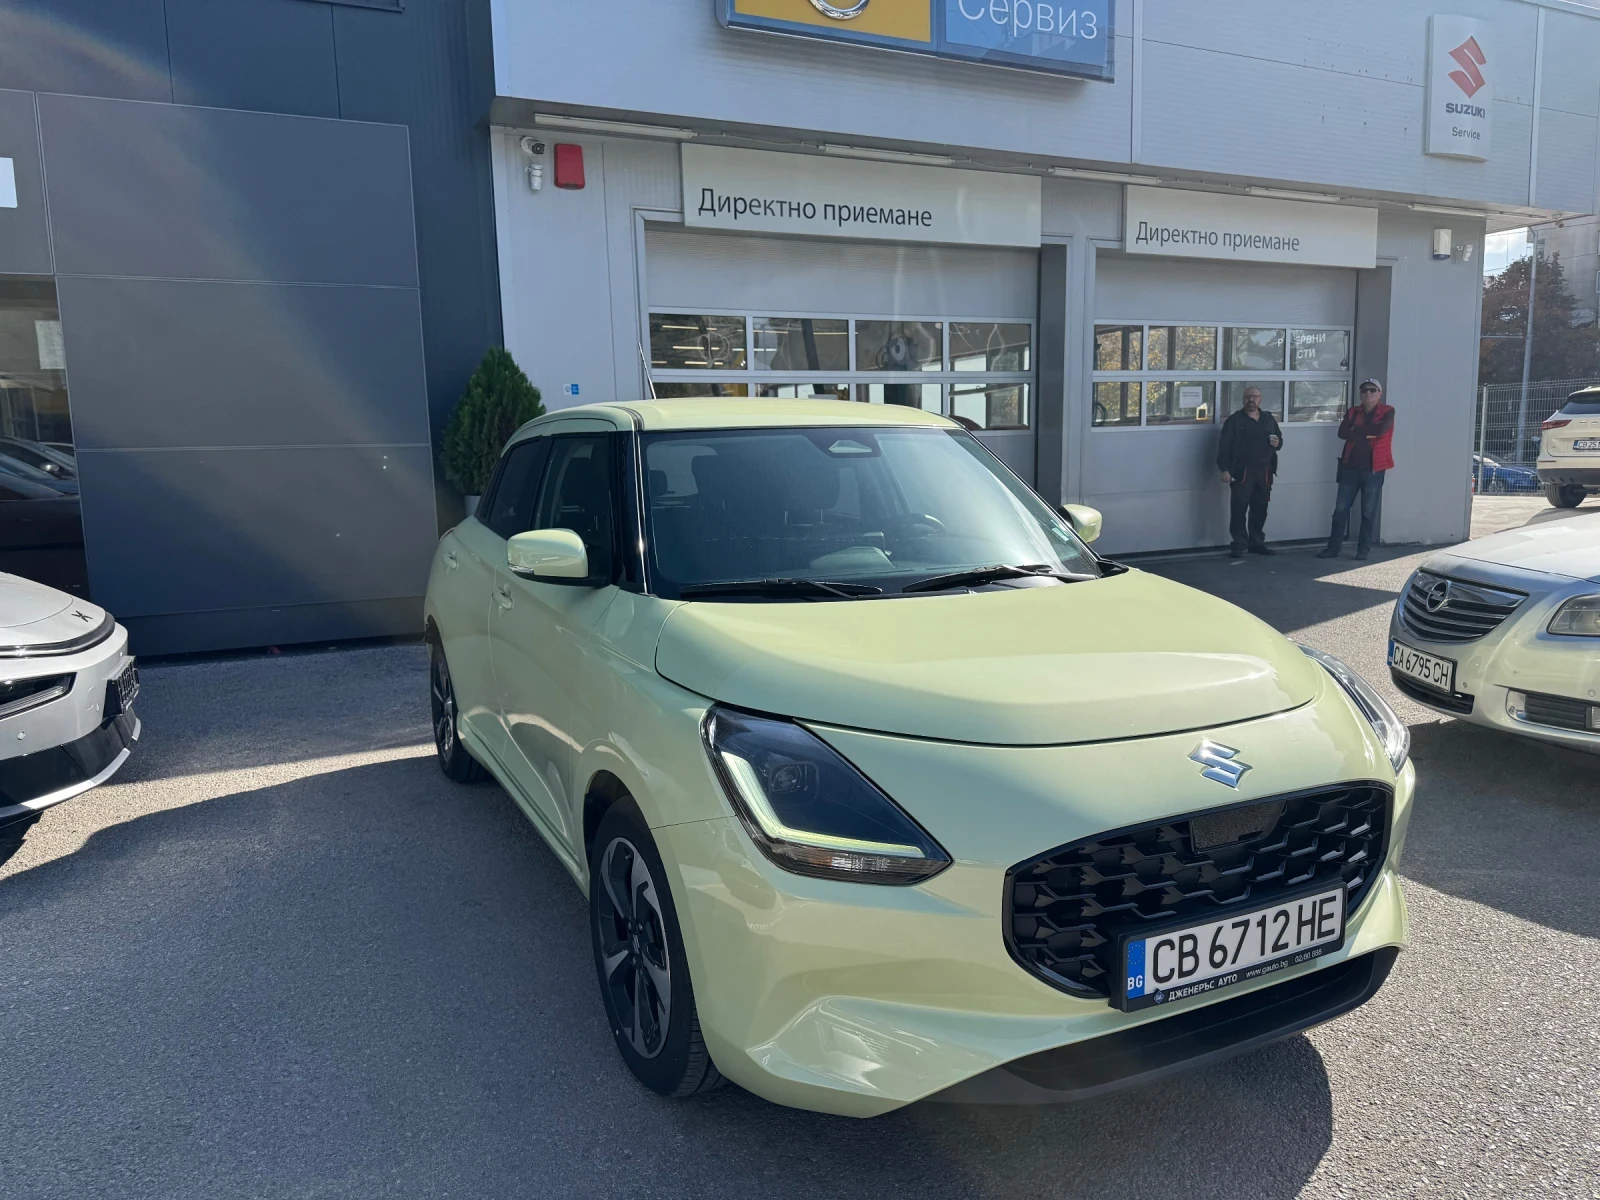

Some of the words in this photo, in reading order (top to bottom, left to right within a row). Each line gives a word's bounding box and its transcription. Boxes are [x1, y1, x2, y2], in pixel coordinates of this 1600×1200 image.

[1445, 102, 1486, 119] SUZUKI
[1451, 126, 1481, 140] Service
[698, 188, 816, 220] Директно
[823, 203, 933, 227] приемане
[1135, 221, 1218, 247] Директно
[1222, 232, 1300, 251] приемане
[1405, 652, 1431, 679] 6795
[1208, 909, 1290, 969] 6712
[1127, 975, 1143, 990] BG
[1245, 960, 1289, 978] www.gauto.bg
[1168, 981, 1215, 1002] ДЖЕНЕРЪС
[1217, 974, 1238, 987] АУТО
